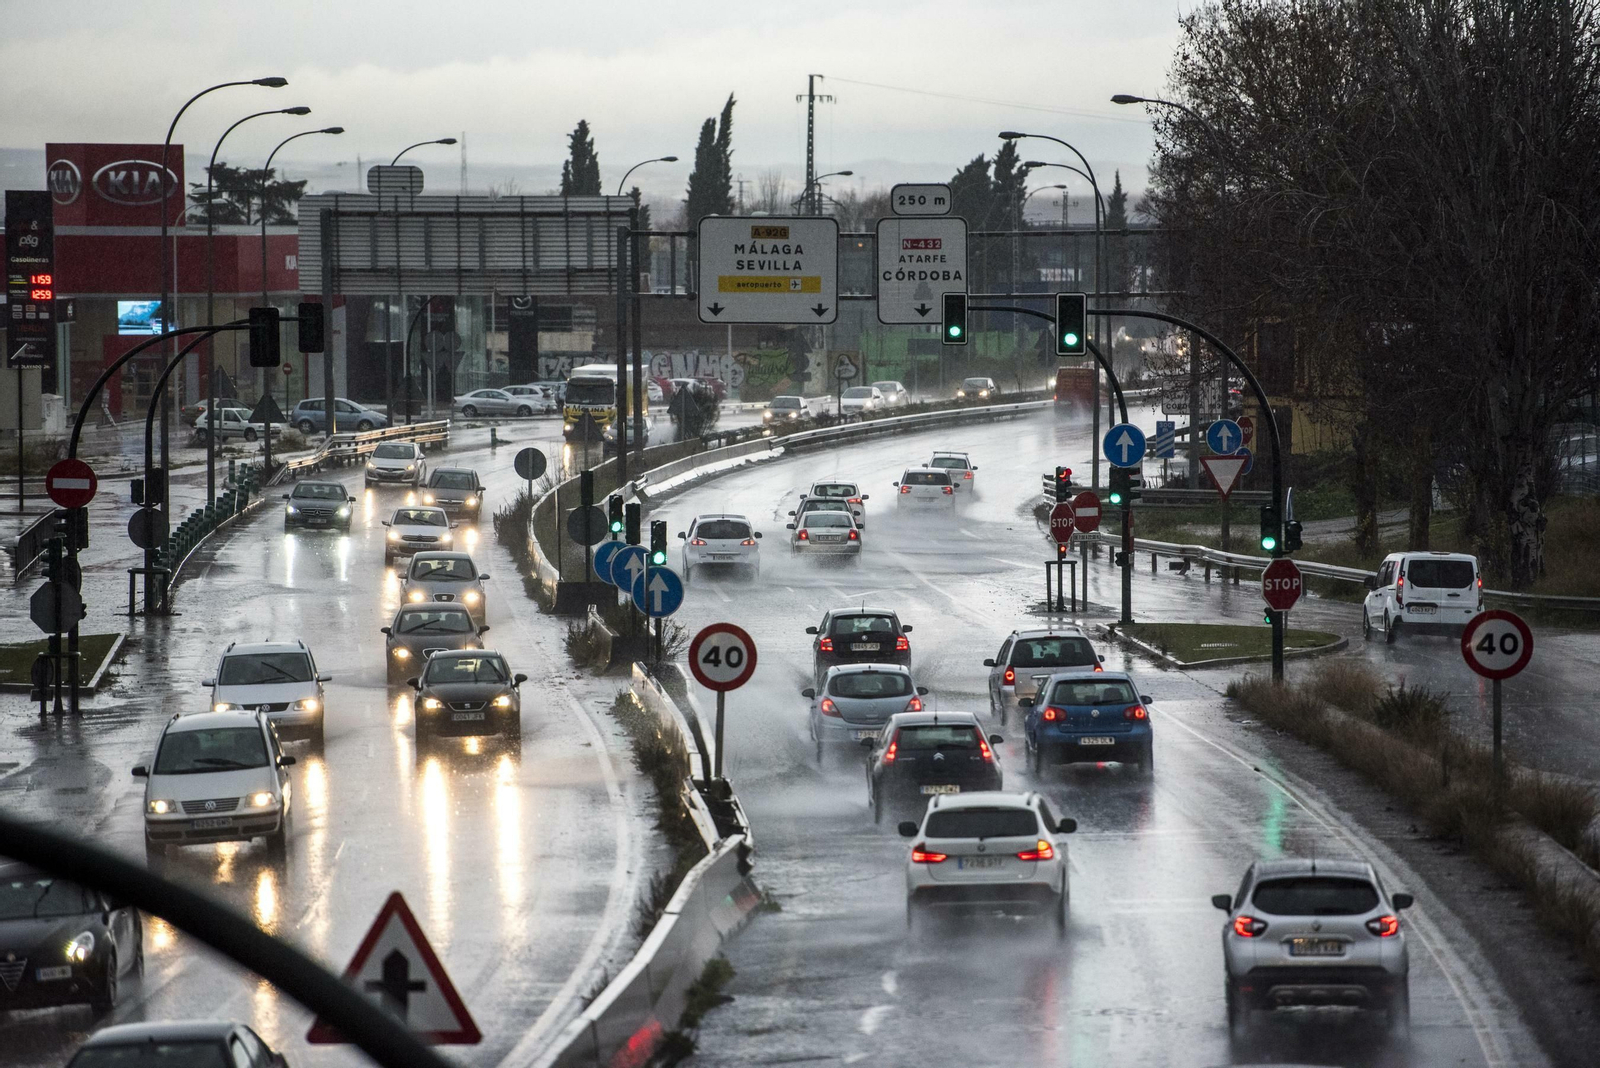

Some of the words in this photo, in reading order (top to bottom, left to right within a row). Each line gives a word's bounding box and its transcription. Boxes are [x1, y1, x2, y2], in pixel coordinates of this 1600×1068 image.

[50, 170, 74, 193] KIA
[108, 170, 165, 195] KIA
[898, 195, 927, 205] 250
[933, 197, 946, 205] m
[752, 227, 788, 238] A-92G
[734, 240, 804, 255] MÁLAGA
[902, 239, 941, 249] N-432
[898, 254, 947, 263] ATARFE
[735, 259, 802, 271] SEVILLA
[882, 267, 963, 282] CÓRDOBA
[736, 281, 782, 290] aeropuerto
[1051, 517, 1074, 528] STOP
[1264, 578, 1300, 591] STOP
[1475, 632, 1519, 656] 40
[702, 645, 744, 669] 40
